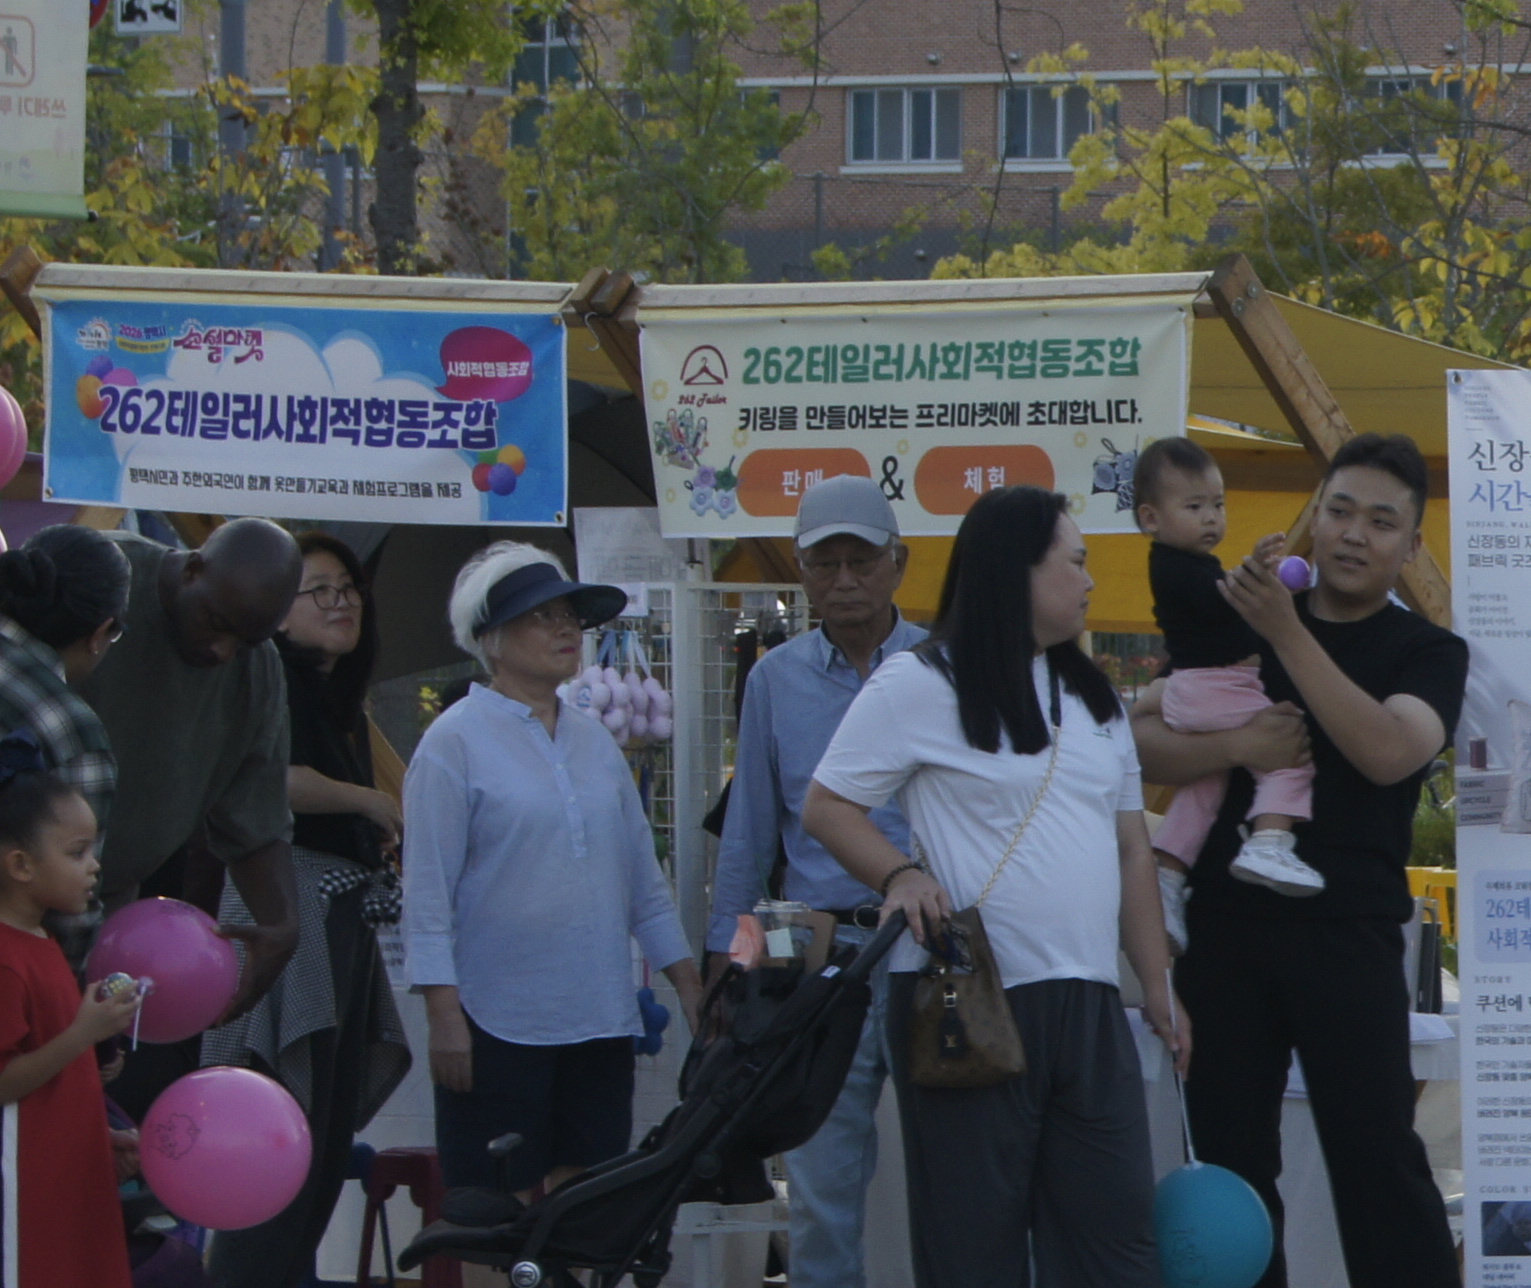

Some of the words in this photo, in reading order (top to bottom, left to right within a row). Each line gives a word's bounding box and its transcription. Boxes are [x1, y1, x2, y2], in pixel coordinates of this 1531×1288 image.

[447, 361, 530, 378] 사회적협동조합
[742, 337, 1141, 385] 262테일러사회적협동조합
[99, 386, 498, 450] 262테일러사회적협동조합
[738, 406, 797, 432] 키링을
[805, 405, 908, 431] 만들어보는
[914, 400, 1020, 428] 프리마켓에
[1026, 399, 1144, 426] 초대합니다.
[247, 473, 272, 491] 함께
[436, 481, 462, 499] 제공
[880, 454, 905, 502] &
[1467, 534, 1520, 550] 신장동의
[1467, 553, 1508, 569] 패브릭
[1475, 975, 1511, 984] STORY
[1475, 994, 1523, 1013] 쿠션에
[1479, 1185, 1517, 1194] COLOR
